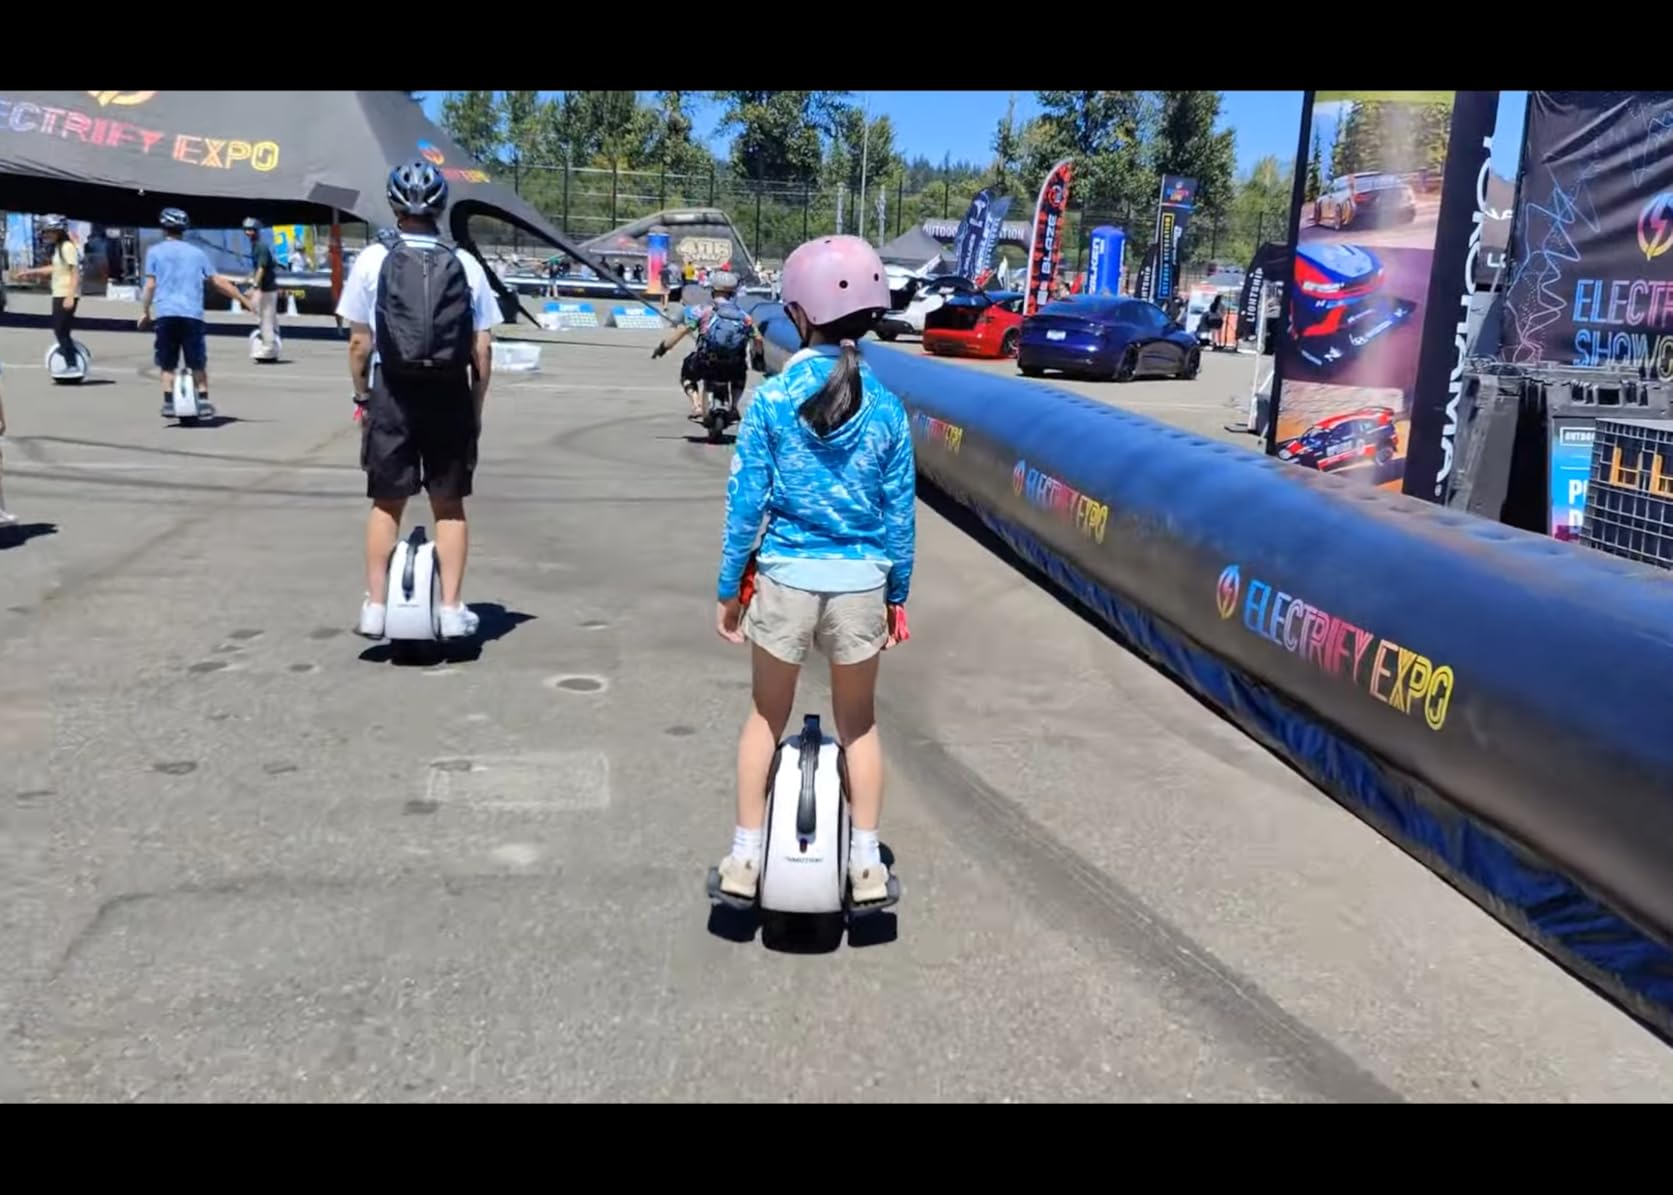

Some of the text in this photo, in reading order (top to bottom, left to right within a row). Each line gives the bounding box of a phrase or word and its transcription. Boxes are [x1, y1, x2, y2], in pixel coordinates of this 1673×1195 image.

[172, 133, 280, 172] EXPO
[1041, 214, 1058, 275] BLAZE
[1076, 494, 1110, 544] EXPO
[1243, 579, 1454, 731] ELECTRIFY EXPO
